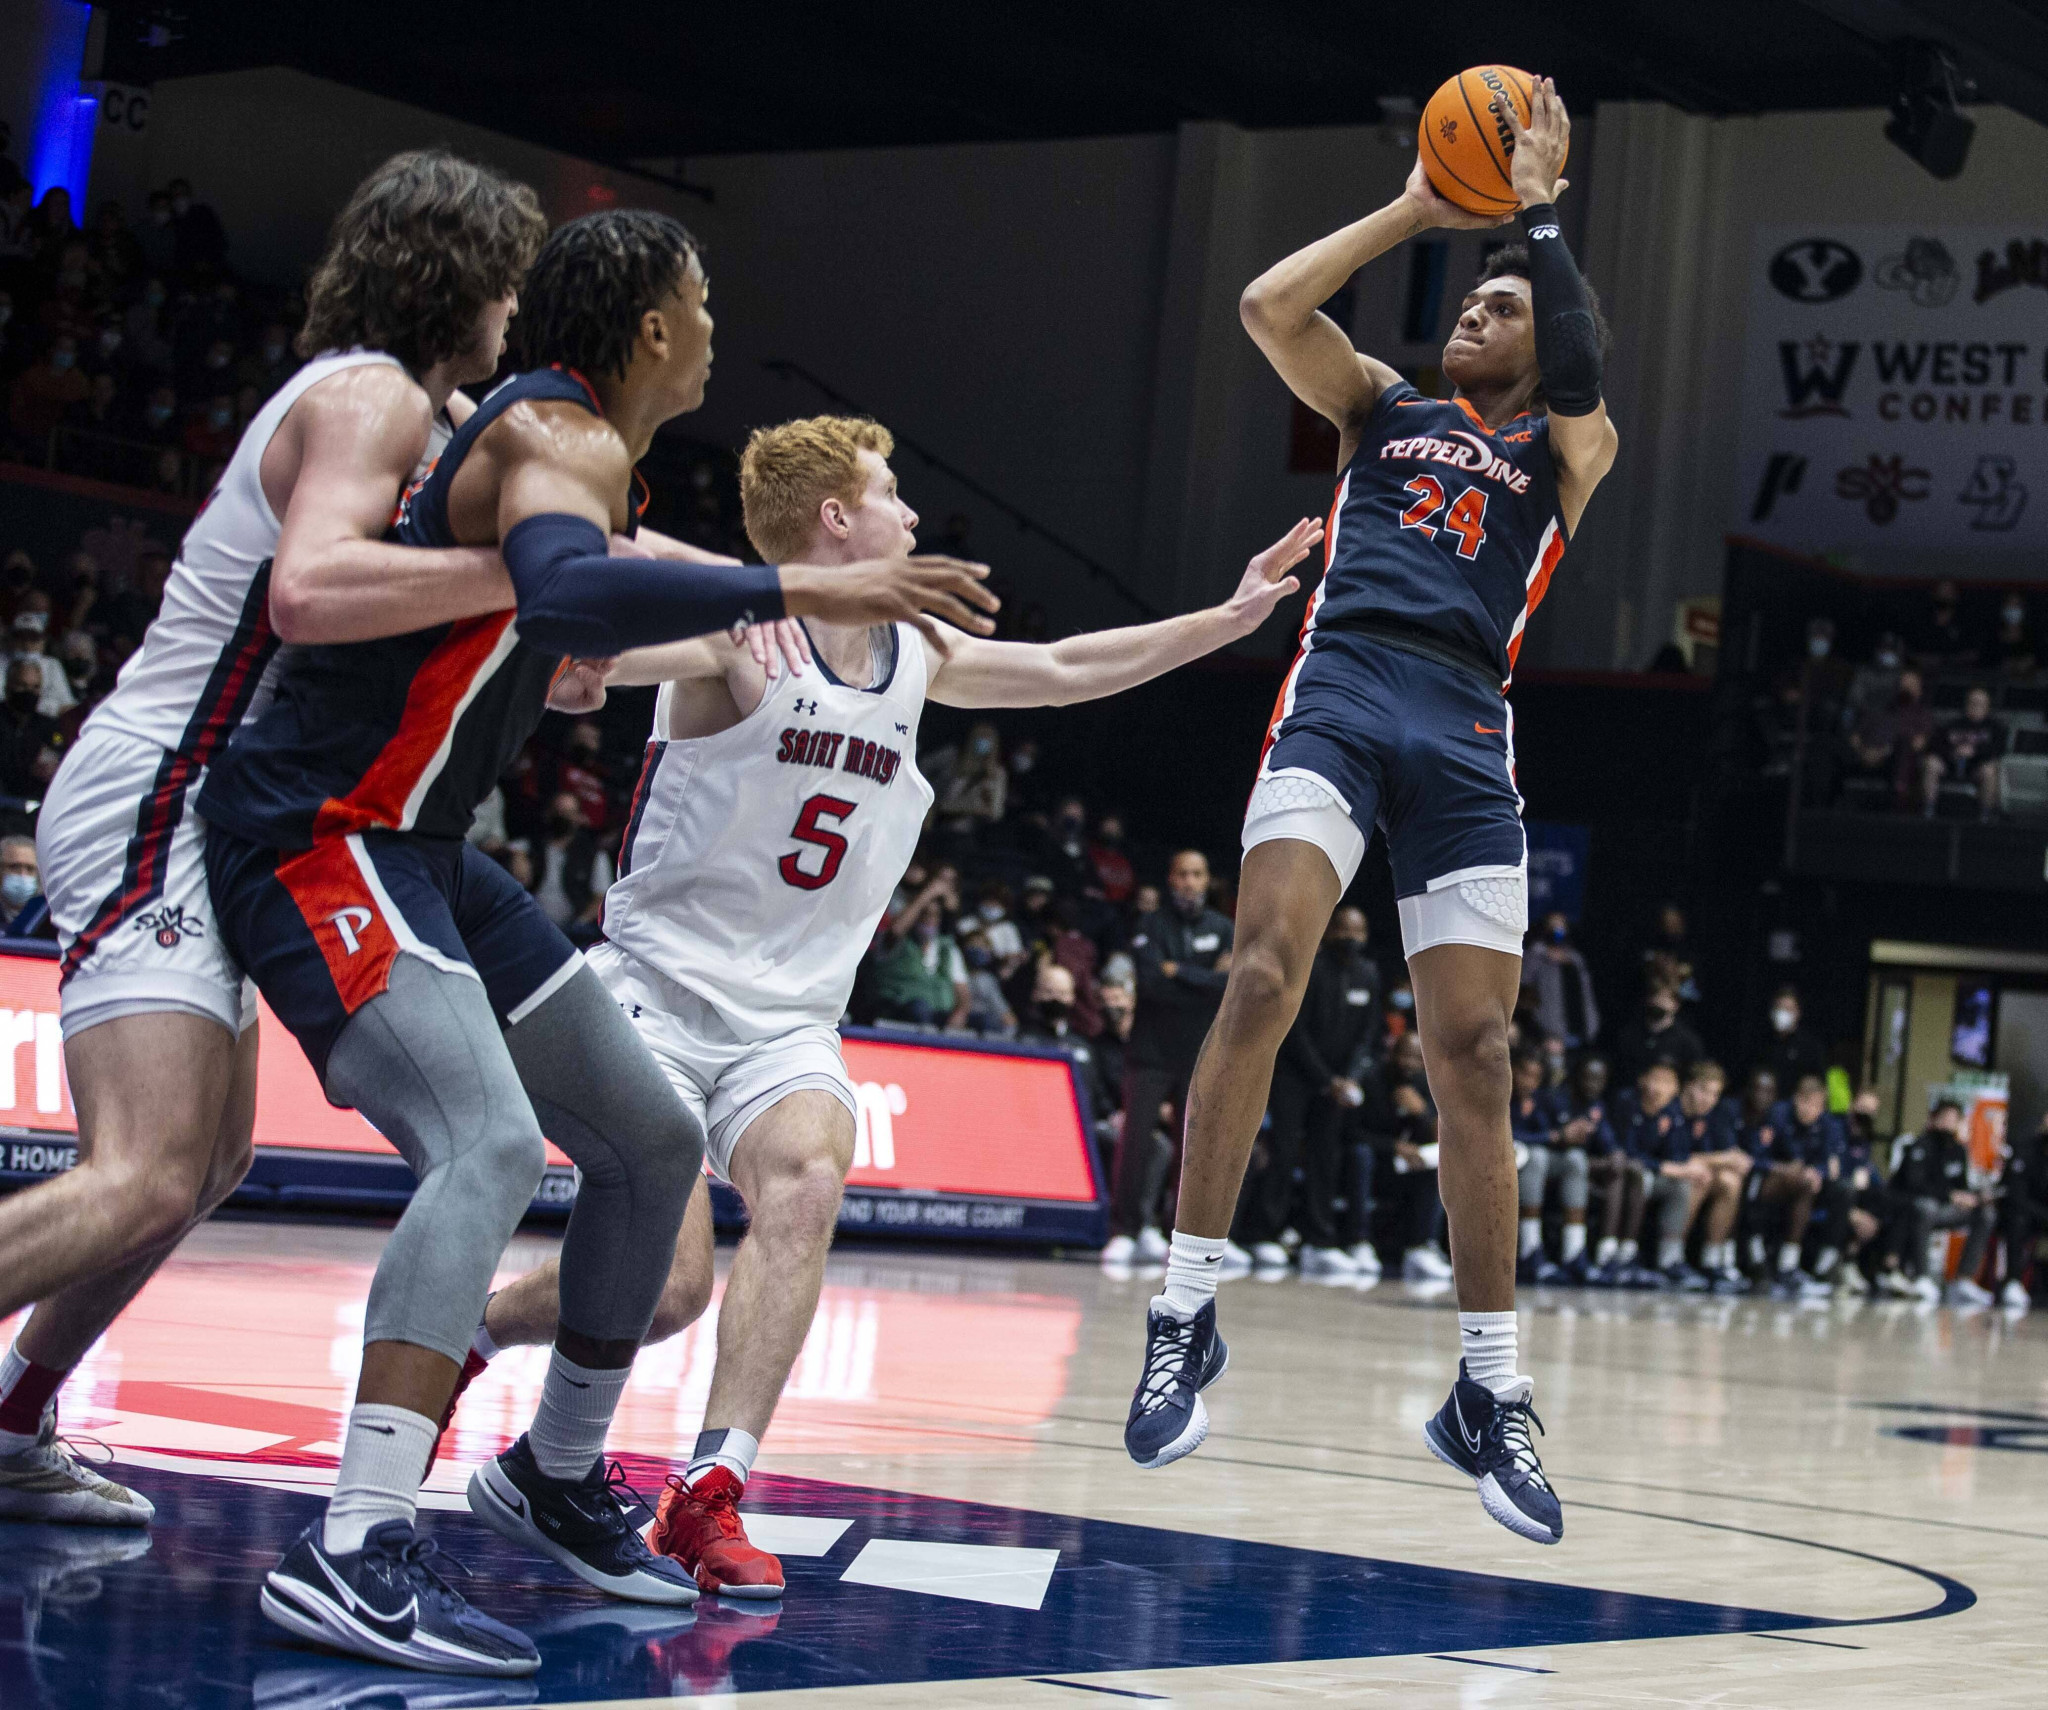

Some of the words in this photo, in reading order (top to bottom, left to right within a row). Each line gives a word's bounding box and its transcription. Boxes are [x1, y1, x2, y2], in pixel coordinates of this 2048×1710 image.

[1872, 341, 2027, 386] WEST
[1878, 392, 2048, 424] CONFE
[1380, 430, 1532, 495] PEPPERDINE
[1400, 474, 1489, 561] 24
[777, 728, 845, 769] SAINT
[778, 793, 859, 890] 5
[324, 906, 373, 955] P
[11, 1145, 79, 1171] HOME
[876, 1199, 919, 1225] YOUR
[922, 1202, 968, 1228] HOME
[971, 1204, 1024, 1230] COURT
